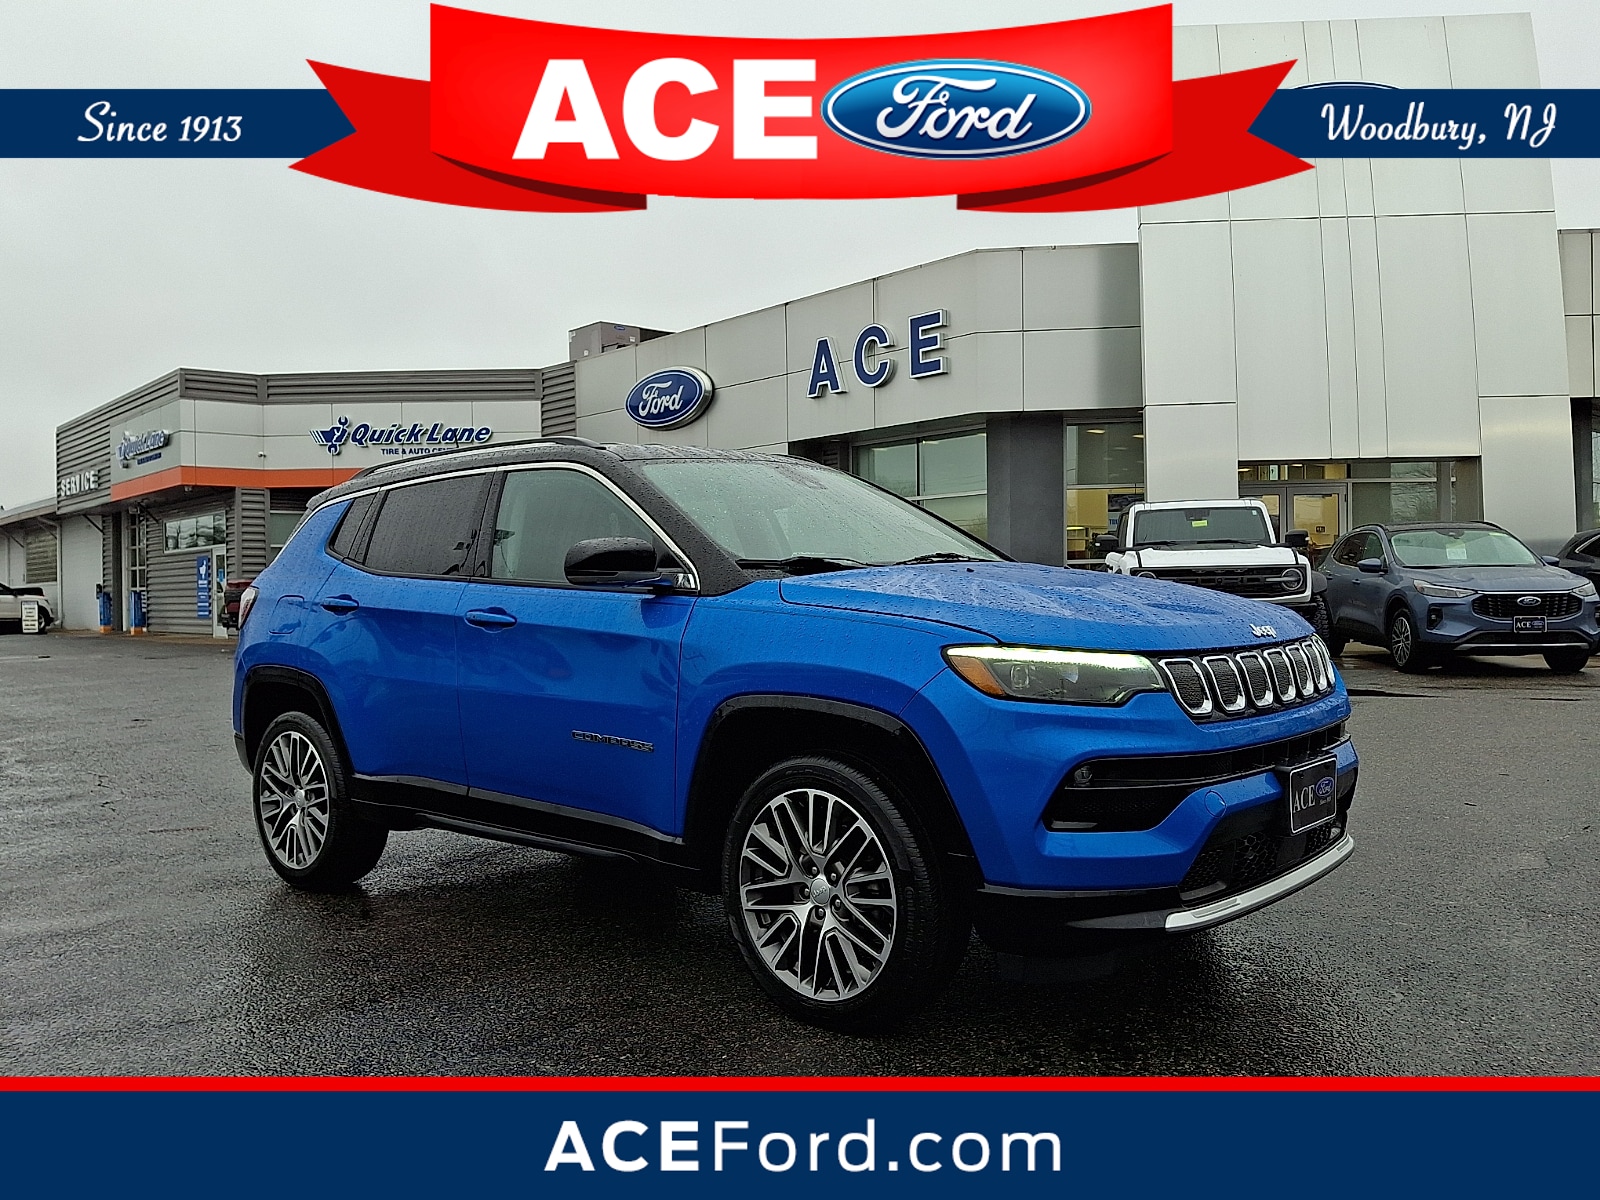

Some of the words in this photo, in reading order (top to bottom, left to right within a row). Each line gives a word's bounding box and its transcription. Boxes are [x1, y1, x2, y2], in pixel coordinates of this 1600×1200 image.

[807, 309, 947, 398] ACE
[639, 381, 684, 416] Ford
[351, 423, 425, 446] Quick
[426, 423, 491, 443] Lane
[60, 470, 99, 496] SERVICE
[1250, 623, 1277, 639] Jeep
[1293, 784, 1315, 813] ACE
